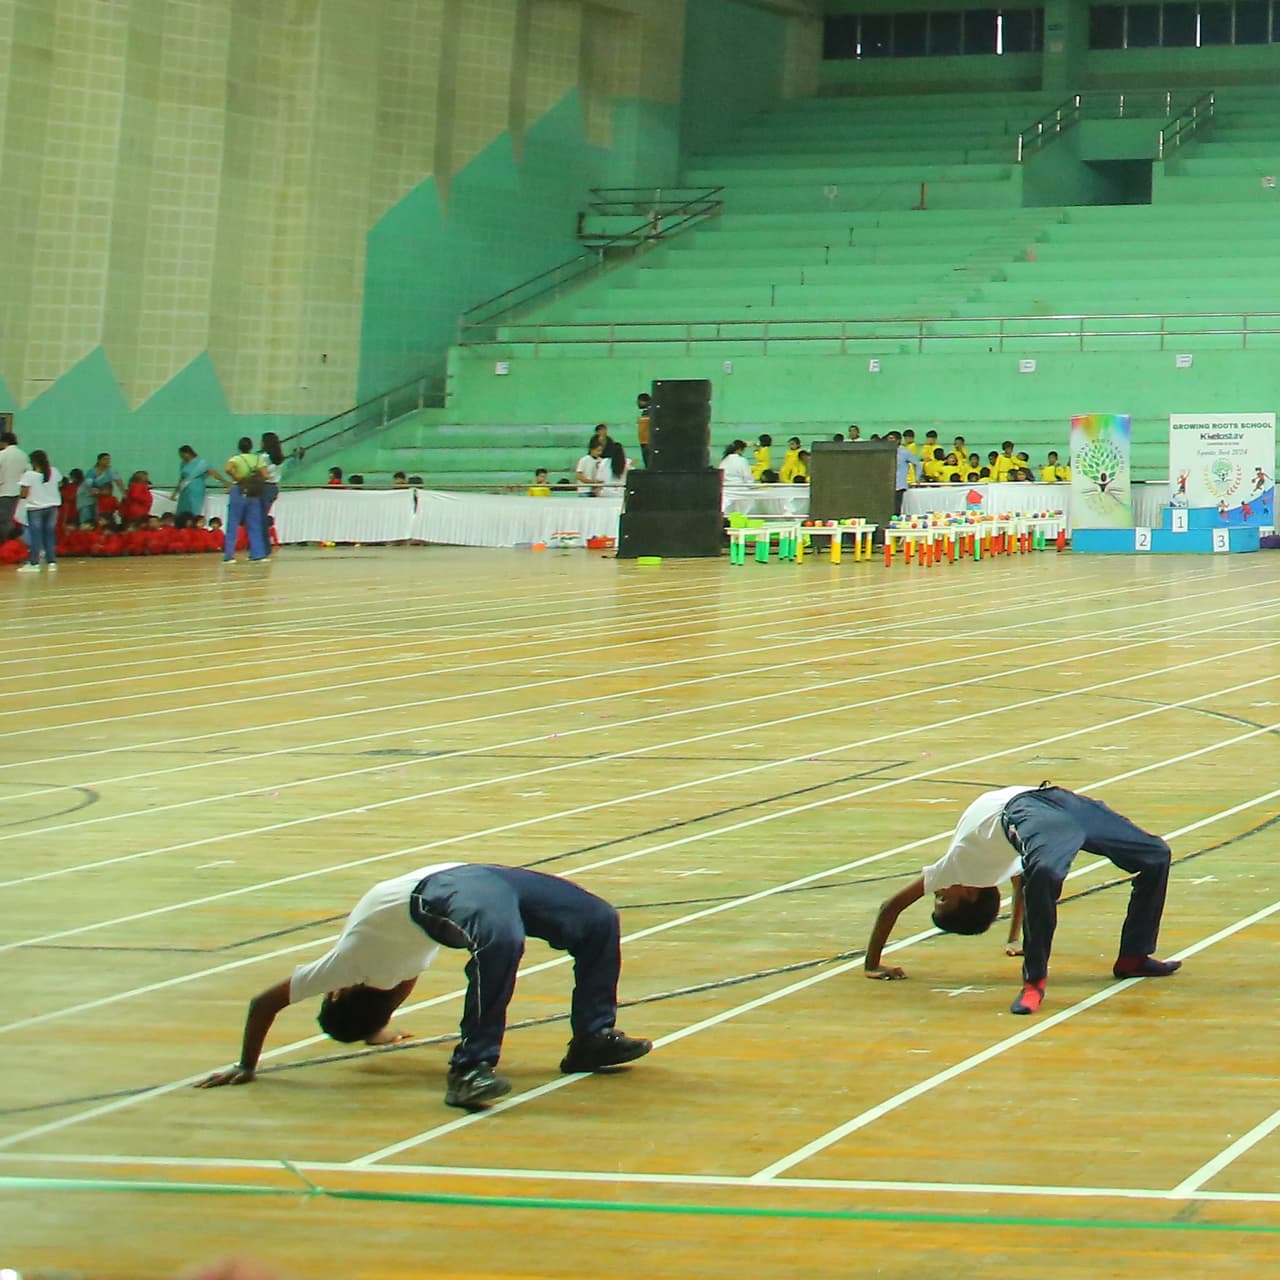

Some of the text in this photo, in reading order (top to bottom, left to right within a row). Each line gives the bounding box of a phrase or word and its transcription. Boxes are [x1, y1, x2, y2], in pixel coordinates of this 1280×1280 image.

[1177, 516, 1184, 529] 1
[1139, 533, 1148, 547] 2
[1217, 534, 1226, 548] 3
